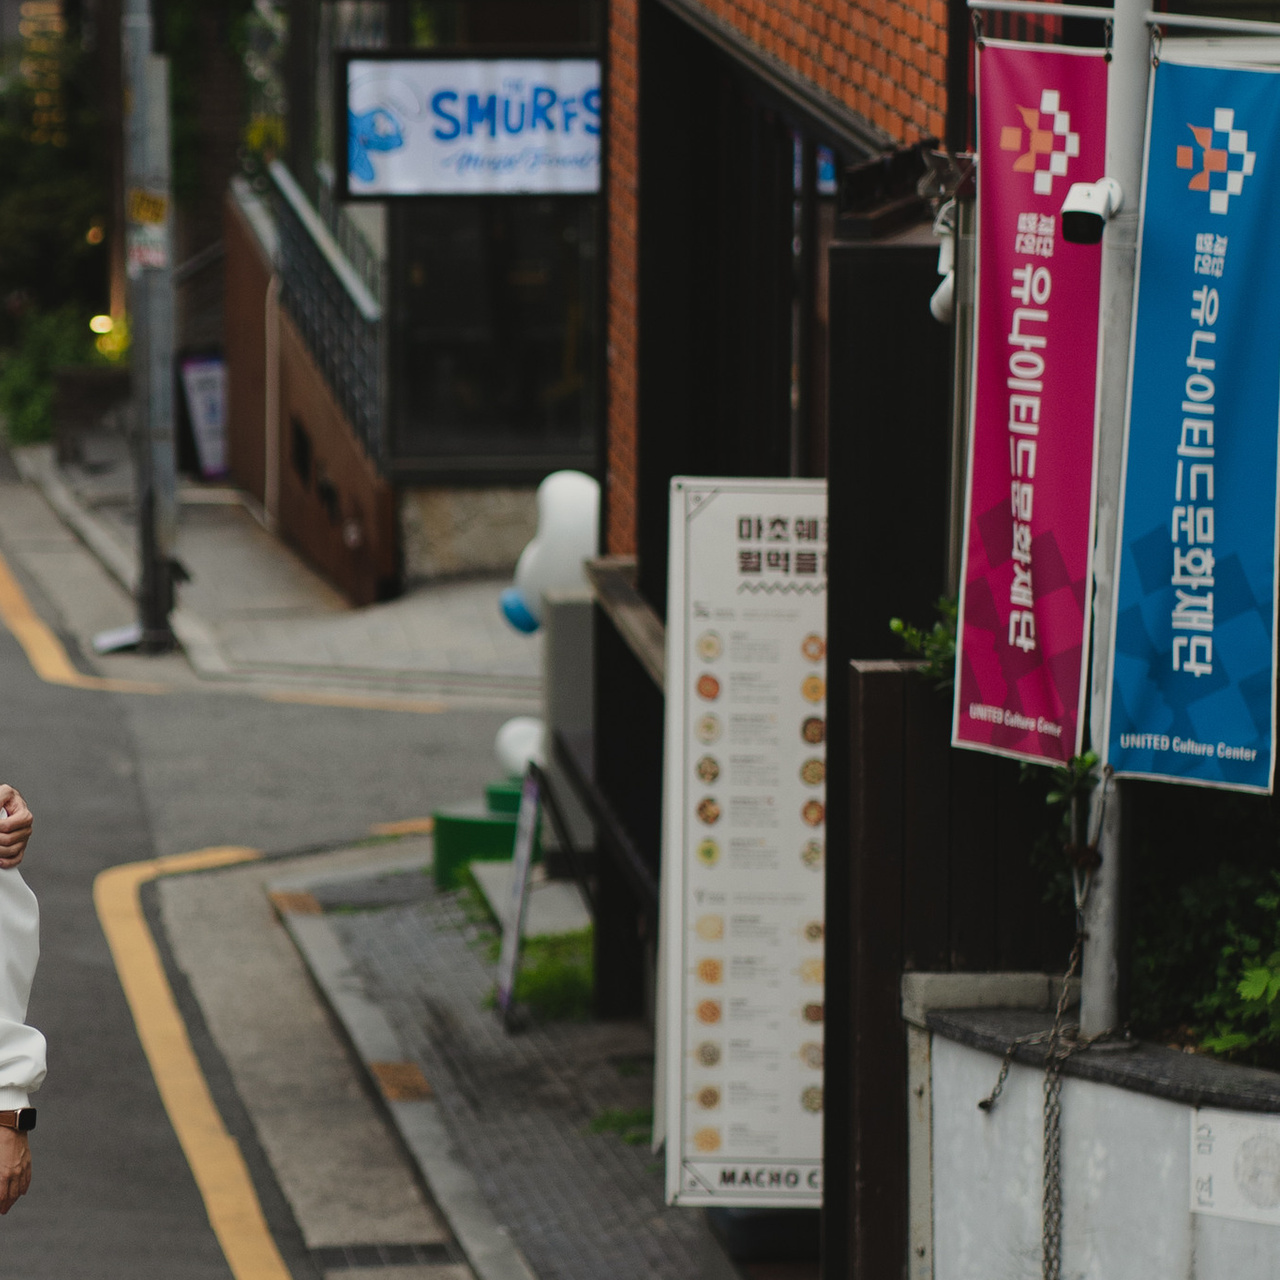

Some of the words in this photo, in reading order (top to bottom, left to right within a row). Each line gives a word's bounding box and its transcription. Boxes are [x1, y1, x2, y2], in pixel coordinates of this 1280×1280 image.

[431, 86, 601, 141] SMURFS
[1007, 263, 1052, 653] 유나이티드문화재단
[1171, 284, 1220, 678] 유나이티드문화재단
[969, 702, 1004, 725] UNITED
[1120, 733, 1170, 751] UNITED
[1172, 736, 1215, 757] Culture
[1217, 741, 1257, 762] Center
[720, 1168, 800, 1188] MACHO
